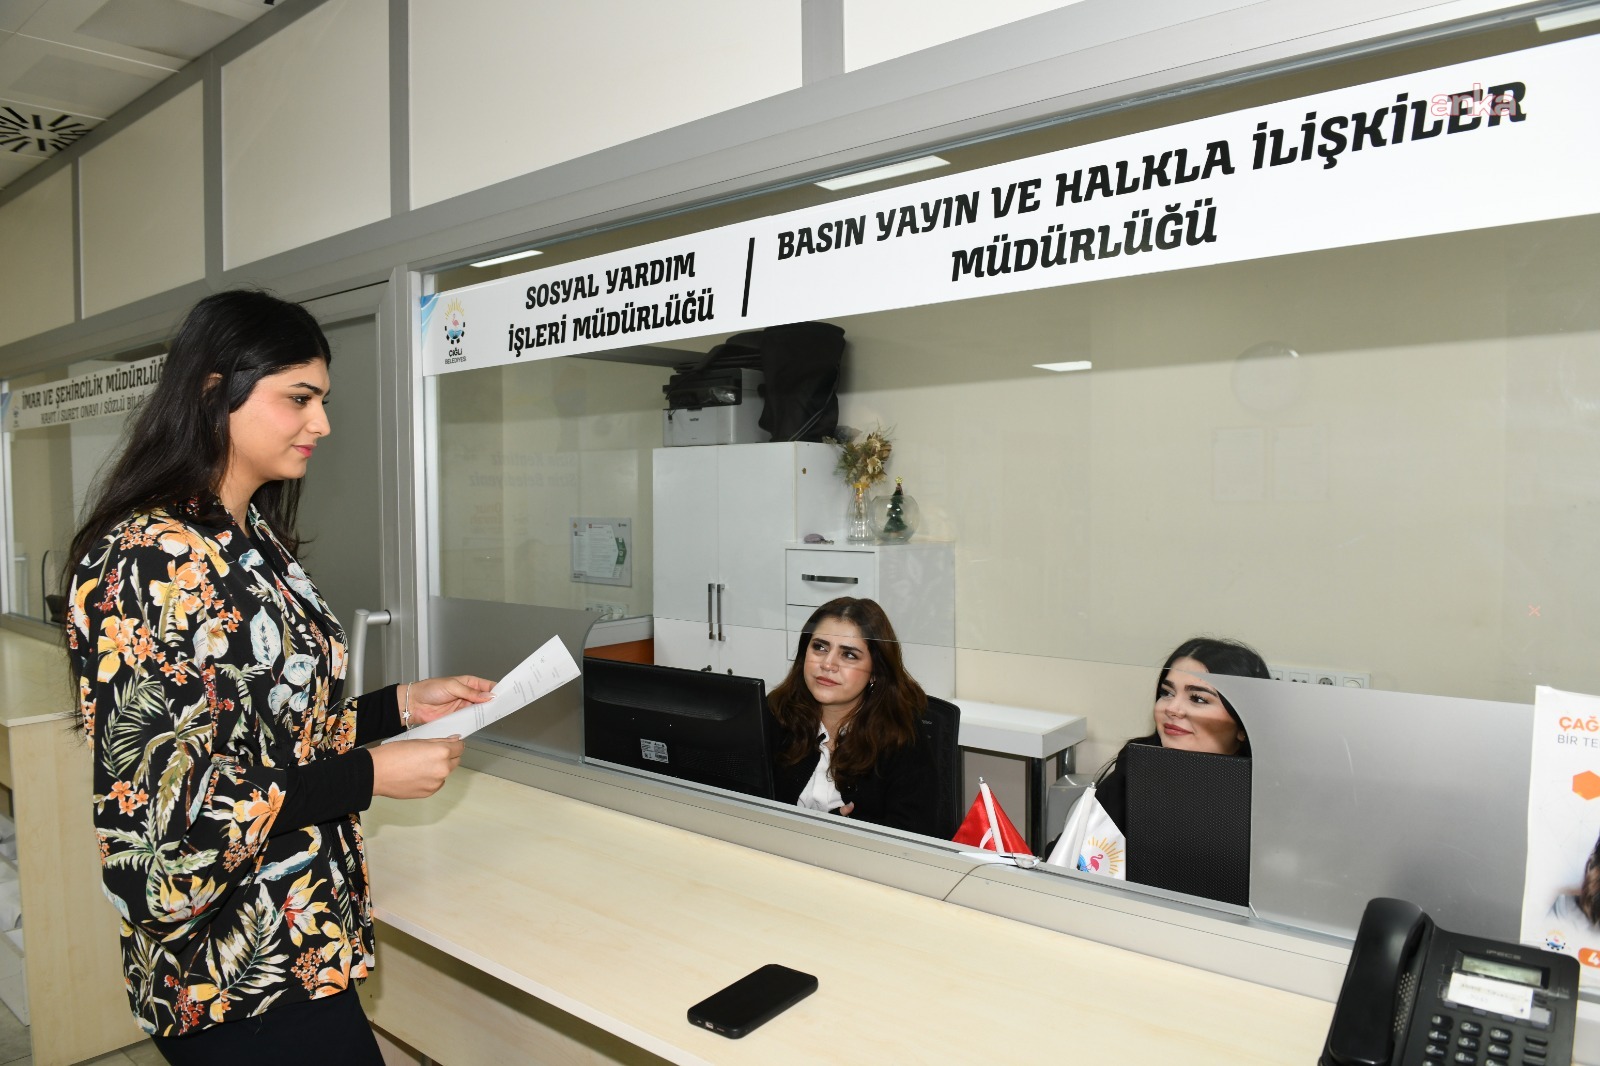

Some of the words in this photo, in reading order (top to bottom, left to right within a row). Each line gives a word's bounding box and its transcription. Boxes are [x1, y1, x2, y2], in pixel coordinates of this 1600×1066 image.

[777, 215, 866, 261] BASIN
[875, 191, 980, 242] YAYIN
[991, 178, 1042, 219] VE
[1055, 140, 1235, 206] HALKLA
[1252, 81, 1527, 170] İLİŞKİLER
[951, 198, 1218, 282] MÜDÜRLÜĞÜ
[526, 273, 600, 310] SOSYAL
[606, 252, 695, 294] YARDIM
[508, 316, 567, 358] İŞLERİ
[572, 287, 715, 342] MÜDÜRLÜĞÜ
[22, 391, 41, 410] İMAR
[44, 389, 53, 406] VE
[55, 374, 103, 409] ŞEHİRCİLİK
[106, 357, 165, 394] MÜDÜRLÜĞ
